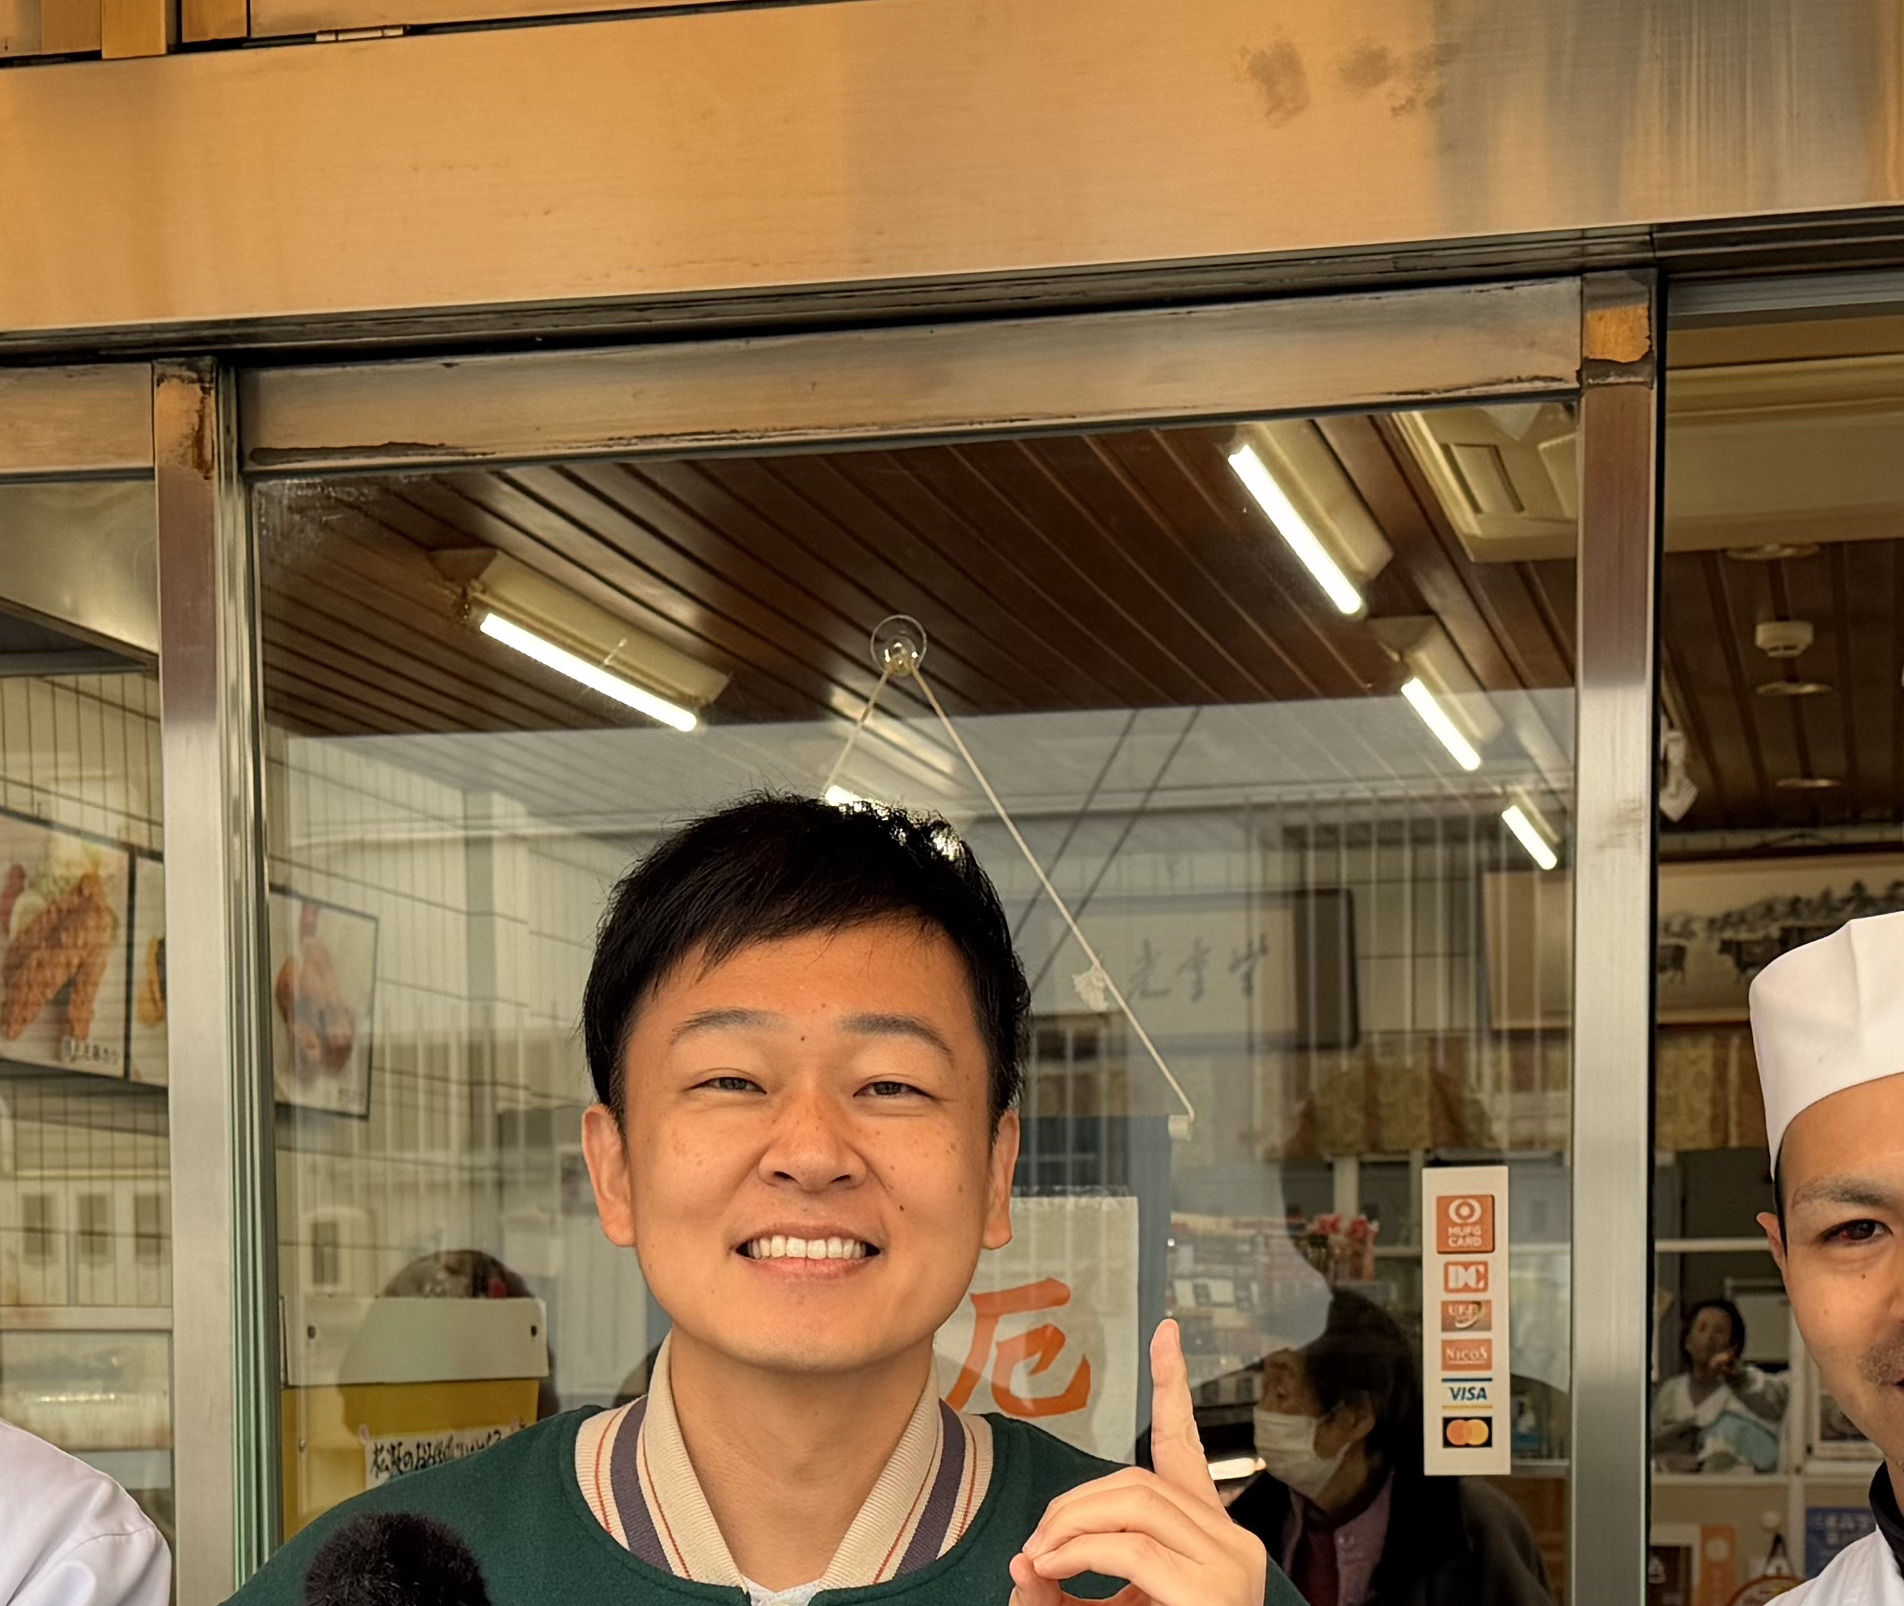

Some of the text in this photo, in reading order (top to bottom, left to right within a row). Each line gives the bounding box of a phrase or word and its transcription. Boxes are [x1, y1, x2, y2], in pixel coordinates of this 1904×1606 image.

[1448, 1237, 1483, 1248] CARD
[1447, 1264, 1486, 1290] DC
[1449, 1386, 1488, 1401] VISA
